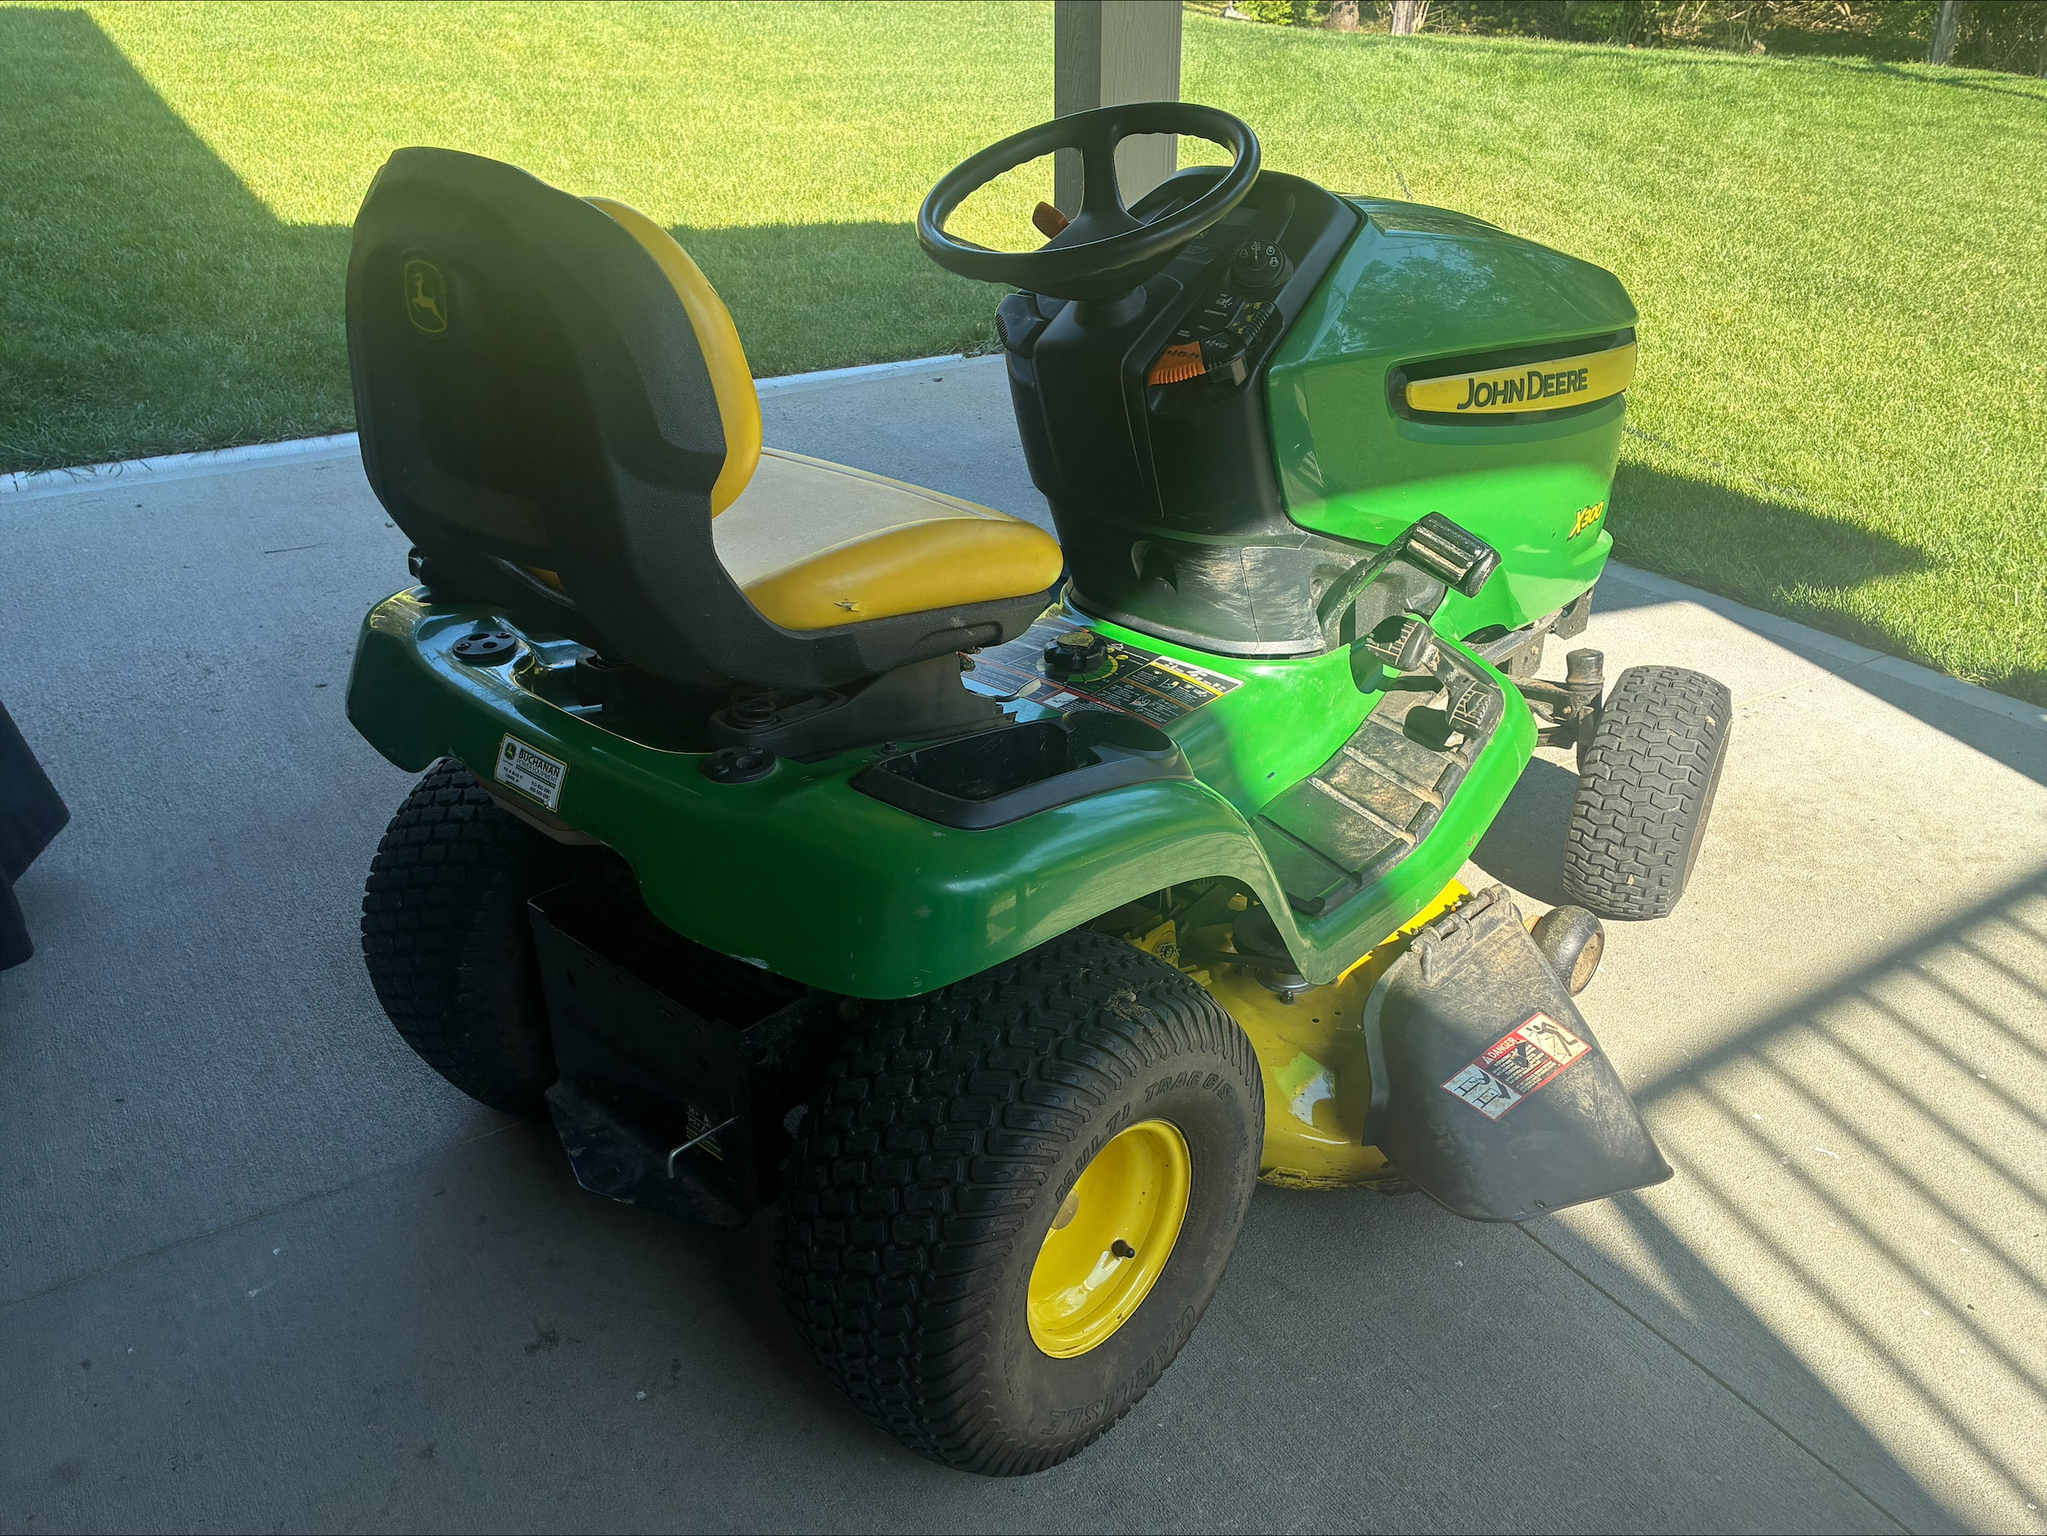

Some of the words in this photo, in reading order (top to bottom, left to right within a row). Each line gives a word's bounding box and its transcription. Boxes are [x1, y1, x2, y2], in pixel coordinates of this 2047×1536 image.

[1457, 378, 1525, 410] JOHN
[1527, 368, 1588, 400] DEERE
[1566, 500, 1605, 542] X300
[518, 749, 560, 778] BUCHANAN
[1487, 1037, 1518, 1059] DANGER
[1145, 1070, 1203, 1102] TRAC
